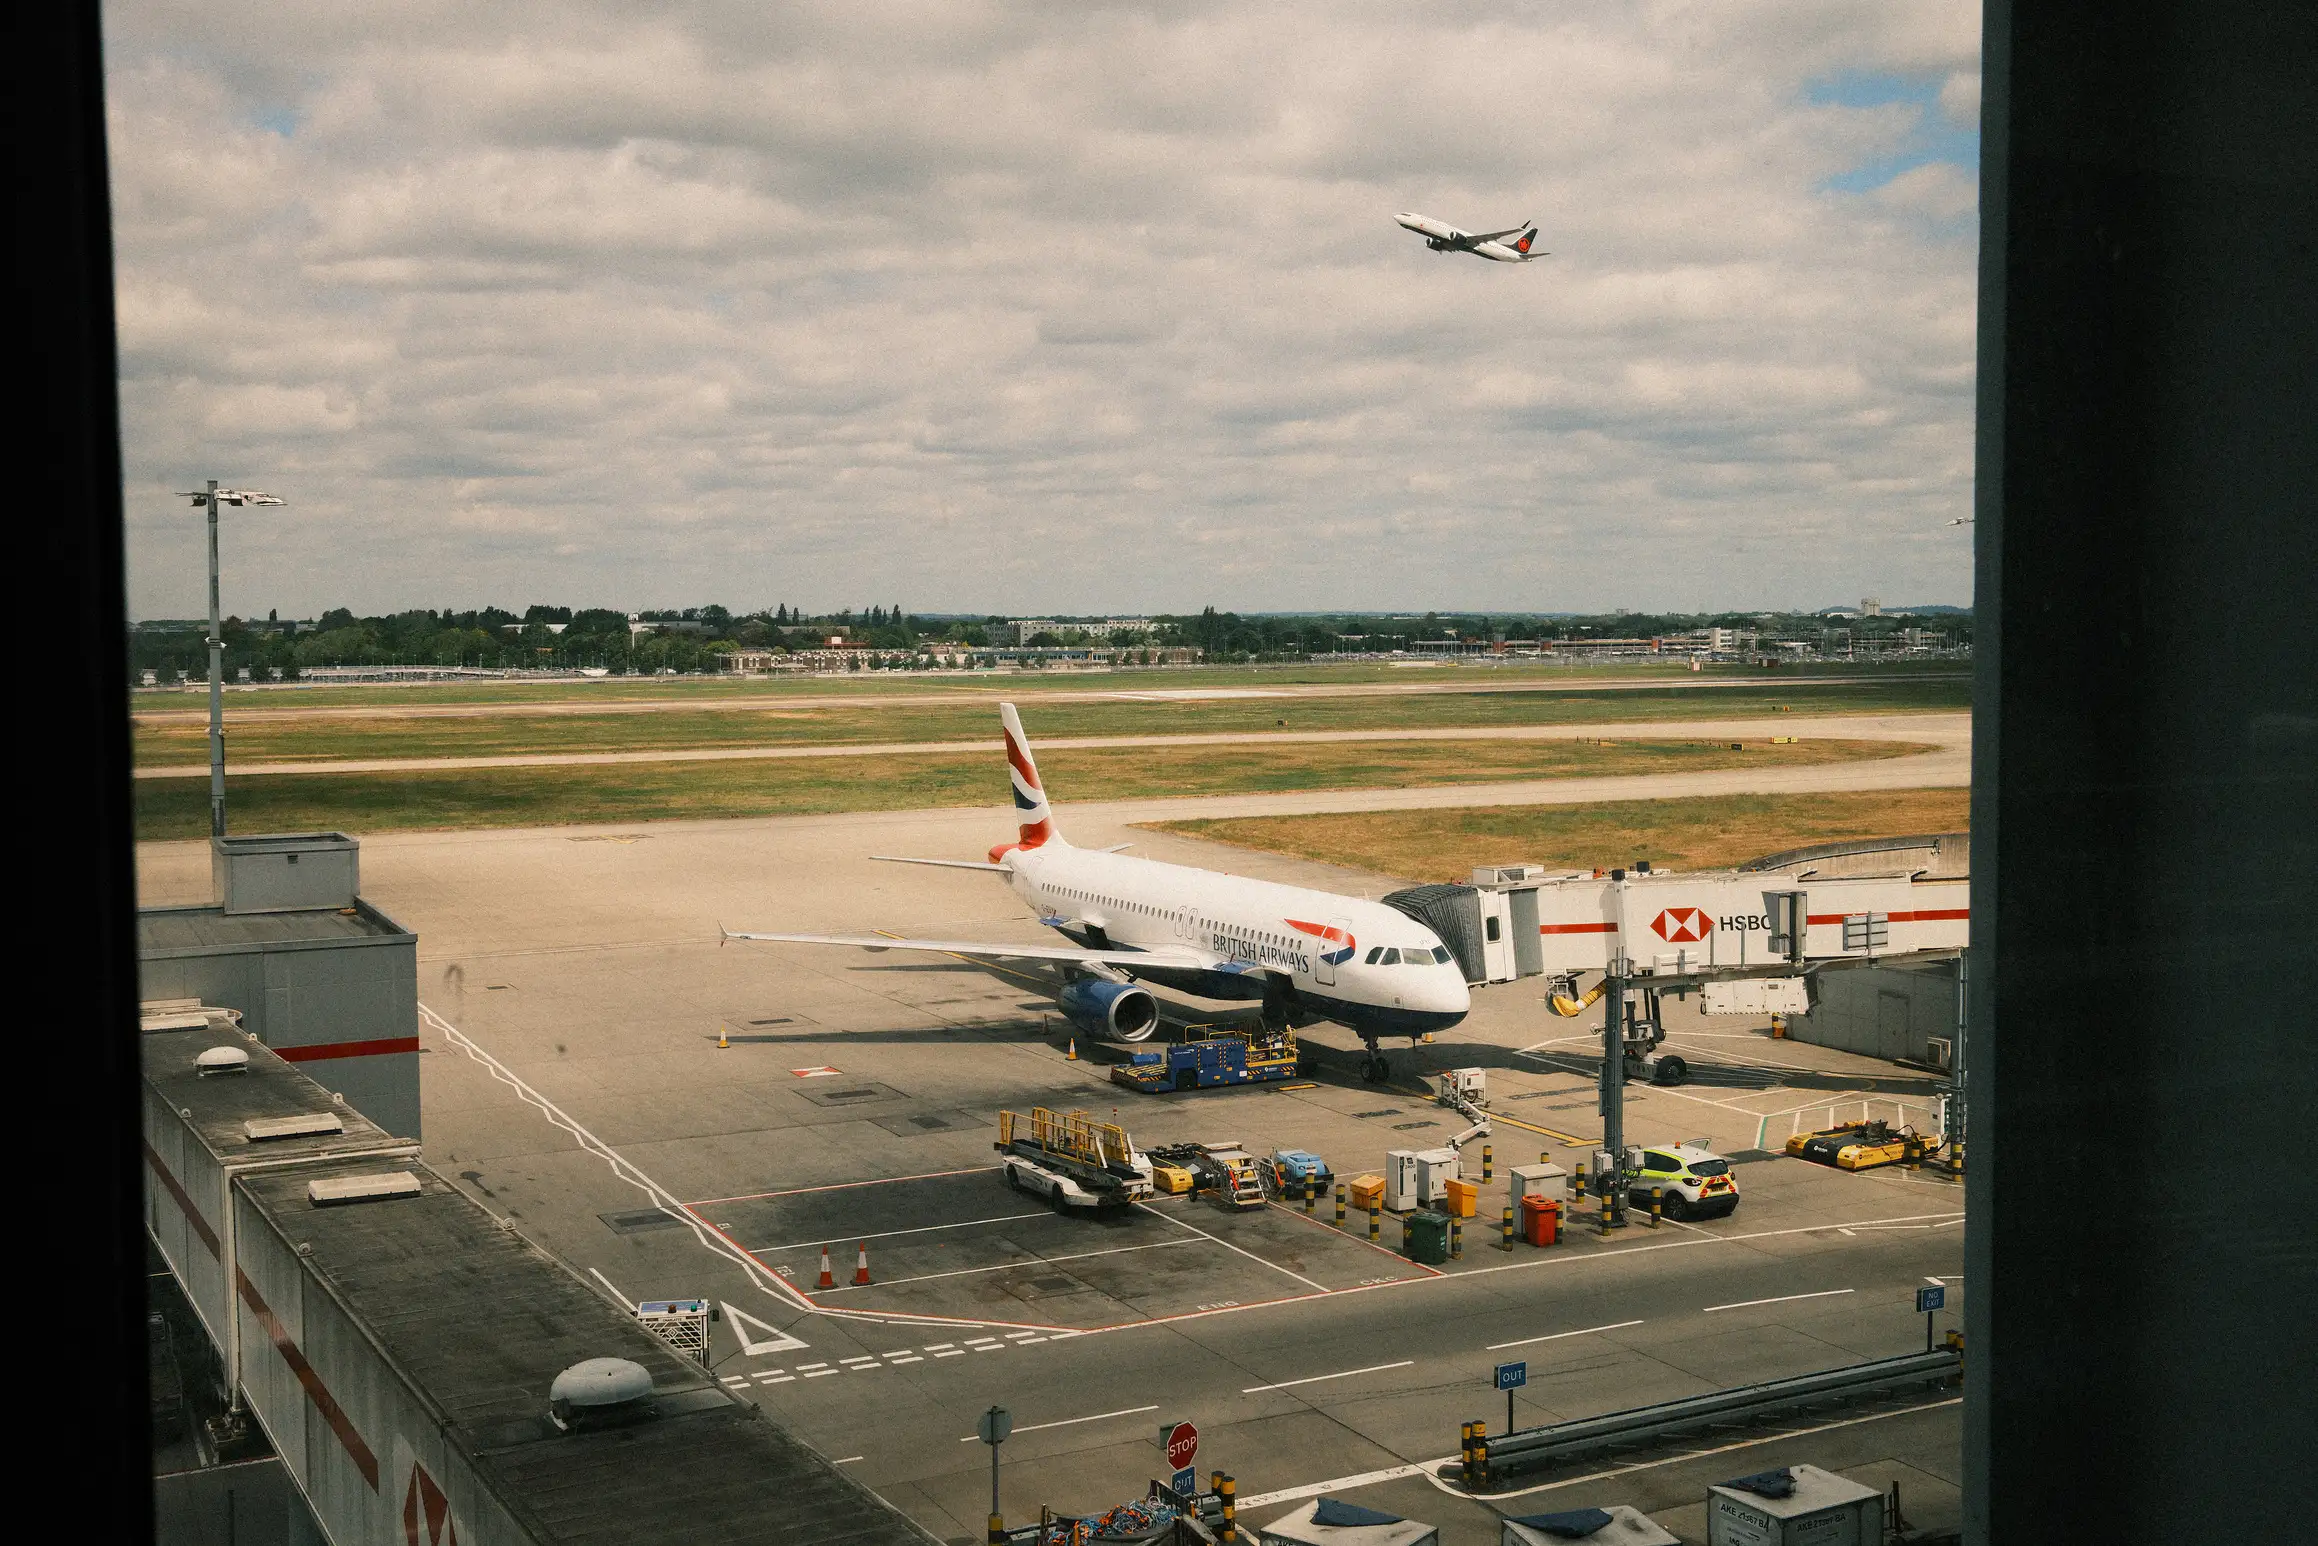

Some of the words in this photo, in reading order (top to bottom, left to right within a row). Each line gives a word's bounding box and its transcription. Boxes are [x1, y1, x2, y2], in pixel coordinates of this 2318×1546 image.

[1720, 915, 1771, 931] HSBC
[1213, 933, 1257, 960] BRITISH
[1259, 945, 1309, 973] AIRWAYS
[1928, 1291, 1938, 1299] NO
[1926, 1299, 1940, 1308] EXIT
[1503, 1370, 1522, 1382] OUT
[1169, 1436, 1197, 1458] STOP
[1174, 1475, 1192, 1491] OUT
[1720, 1503, 1737, 1516] AKE
[1796, 1520, 1812, 1532] AKE
